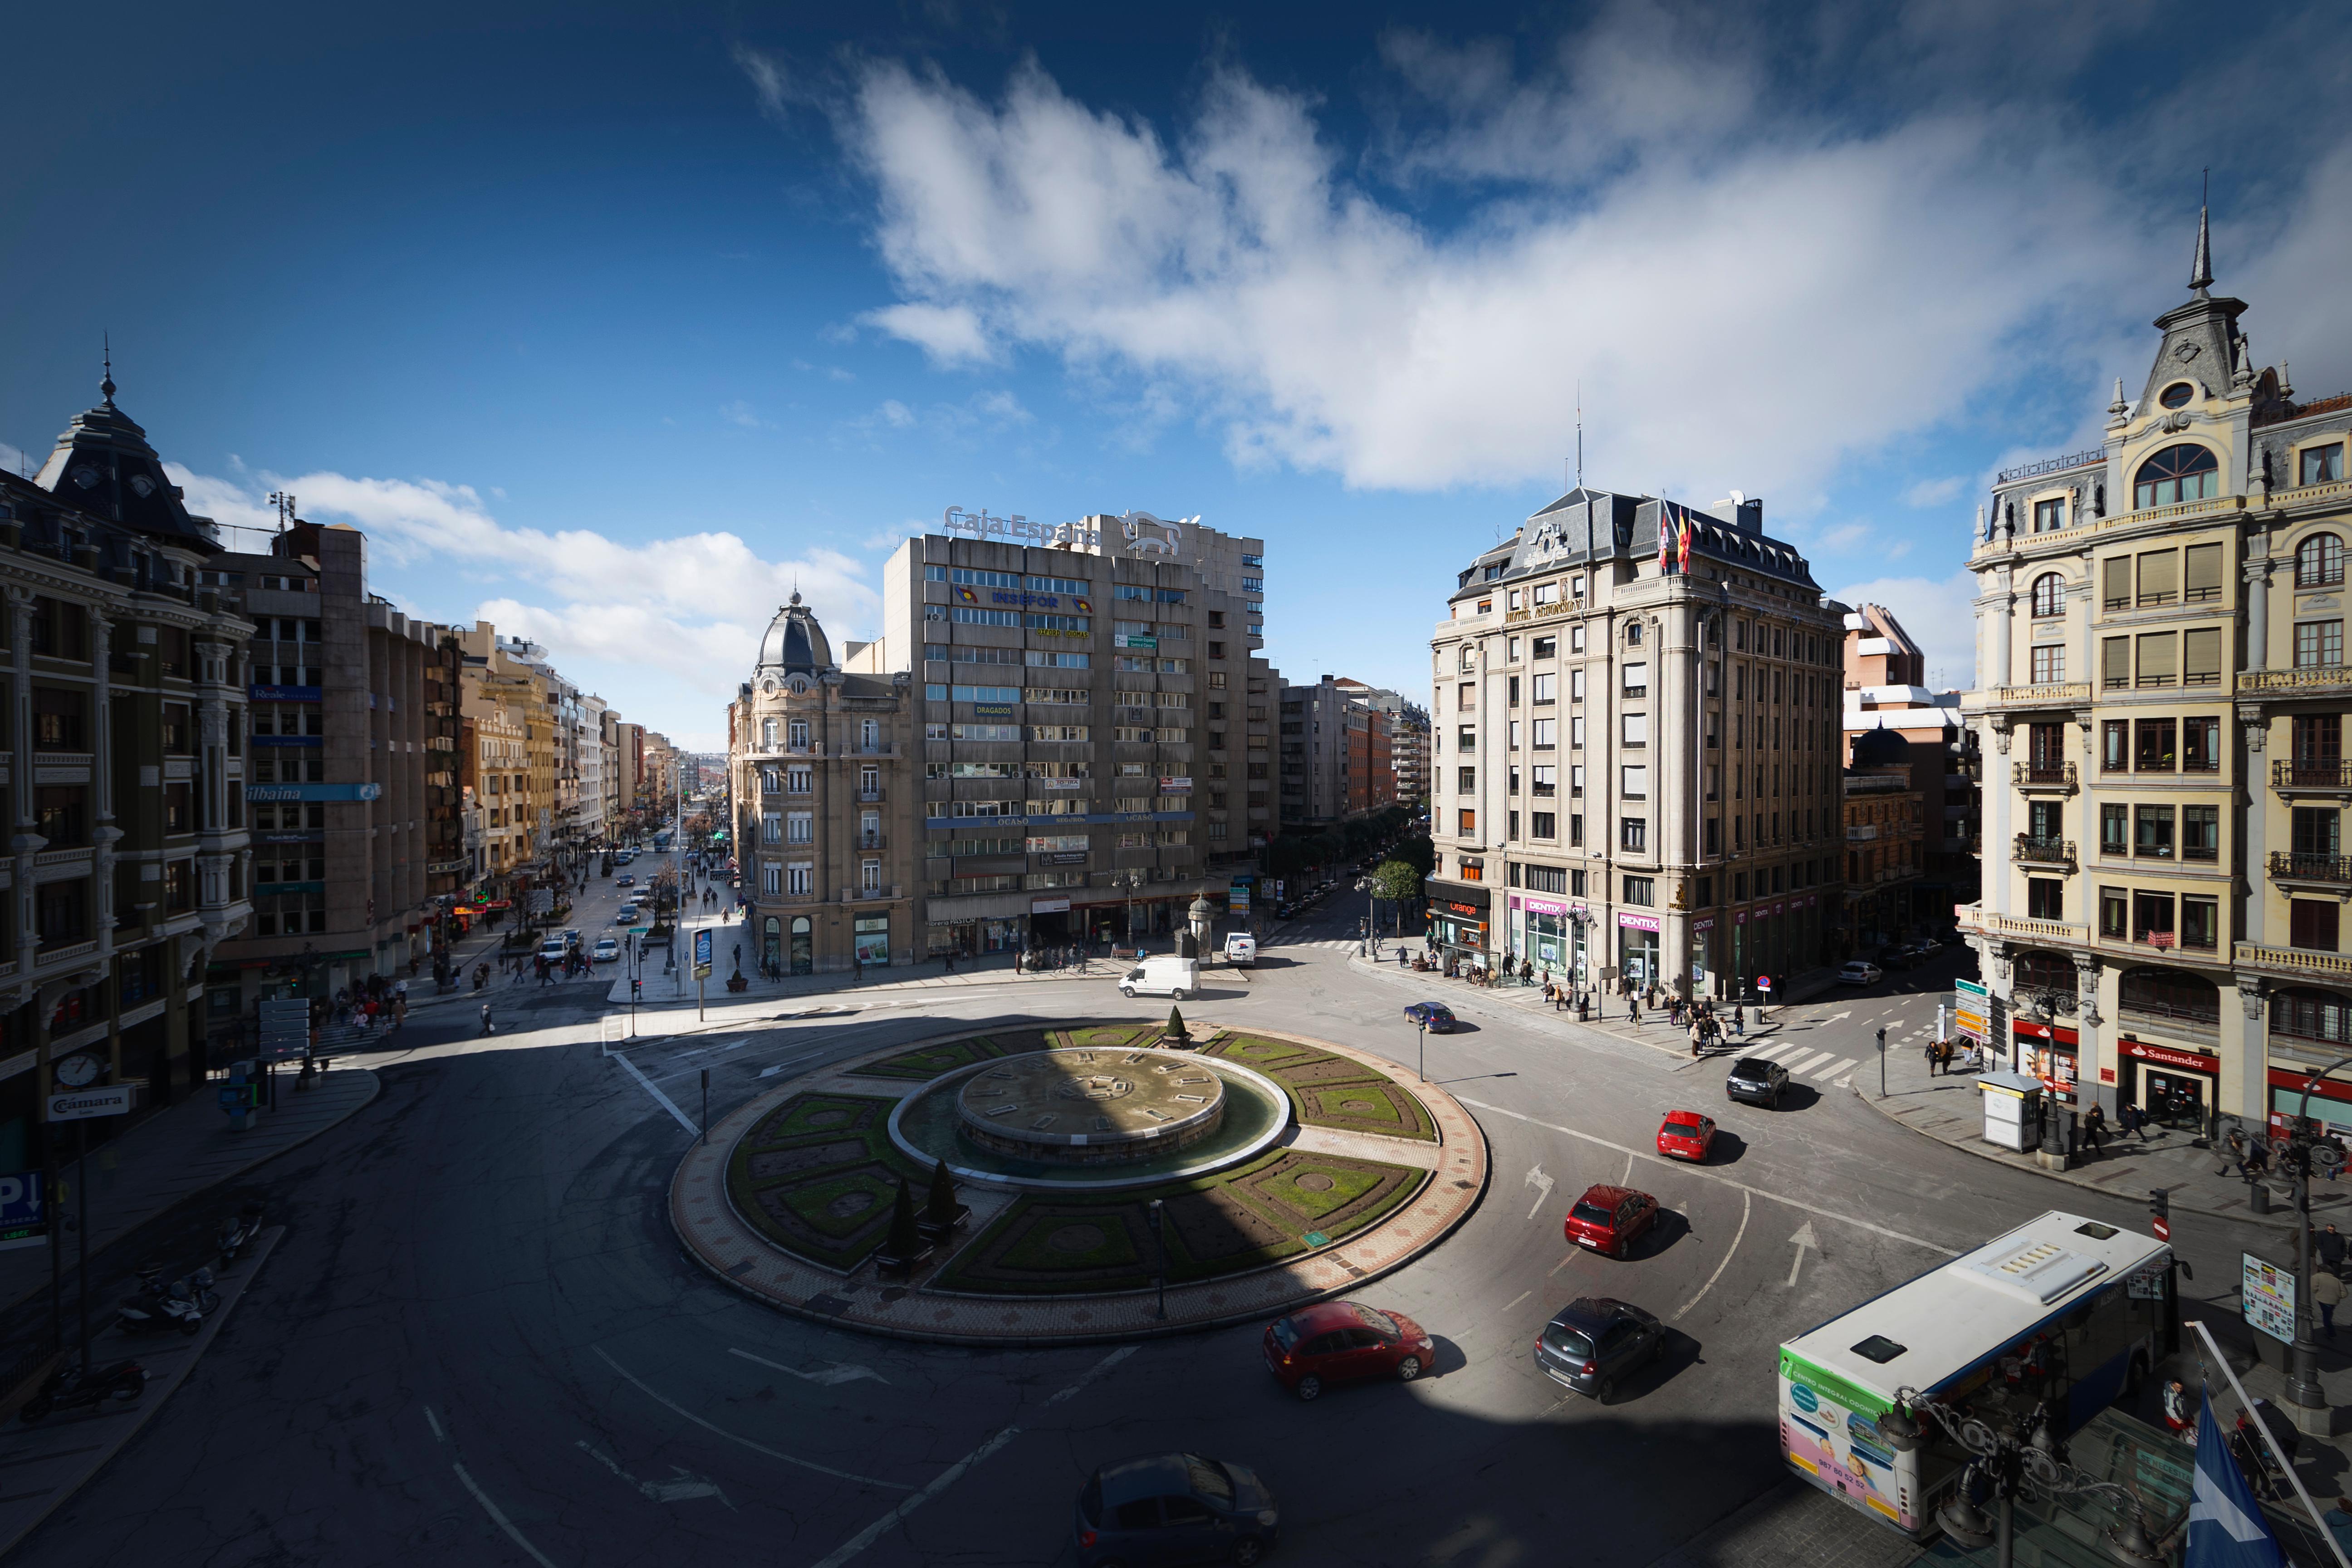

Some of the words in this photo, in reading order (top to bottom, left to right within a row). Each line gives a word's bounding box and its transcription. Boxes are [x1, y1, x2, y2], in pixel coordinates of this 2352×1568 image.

[944, 505, 1005, 540] Caja
[1011, 514, 1102, 547] España
[993, 592, 1058, 608] INSEFOR
[1506, 609, 1531, 623] HOTEL
[1535, 601, 1573, 618] ALFONSO
[1574, 599, 1583, 610] V
[255, 689, 285, 699] Reale
[246, 787, 301, 800] ilbaina
[1450, 902, 1476, 915] Orange
[1529, 902, 1560, 913] DENTIX
[1620, 915, 1658, 929] DENTIX
[1694, 919, 1714, 930] DENTIX
[2147, 1049, 2204, 1067] Santander
[0, 1177, 23, 1218] P
[1793, 1371, 1816, 1386] CENTRO
[1818, 1384, 1848, 1402] INTEGRAL
[2141, 1454, 2151, 1464] SE
[1819, 1459, 1832, 1470] 987
[1834, 1467, 1842, 1476] 80
[1845, 1474, 1853, 1484] 52
[1856, 1480, 1865, 1490] 52
